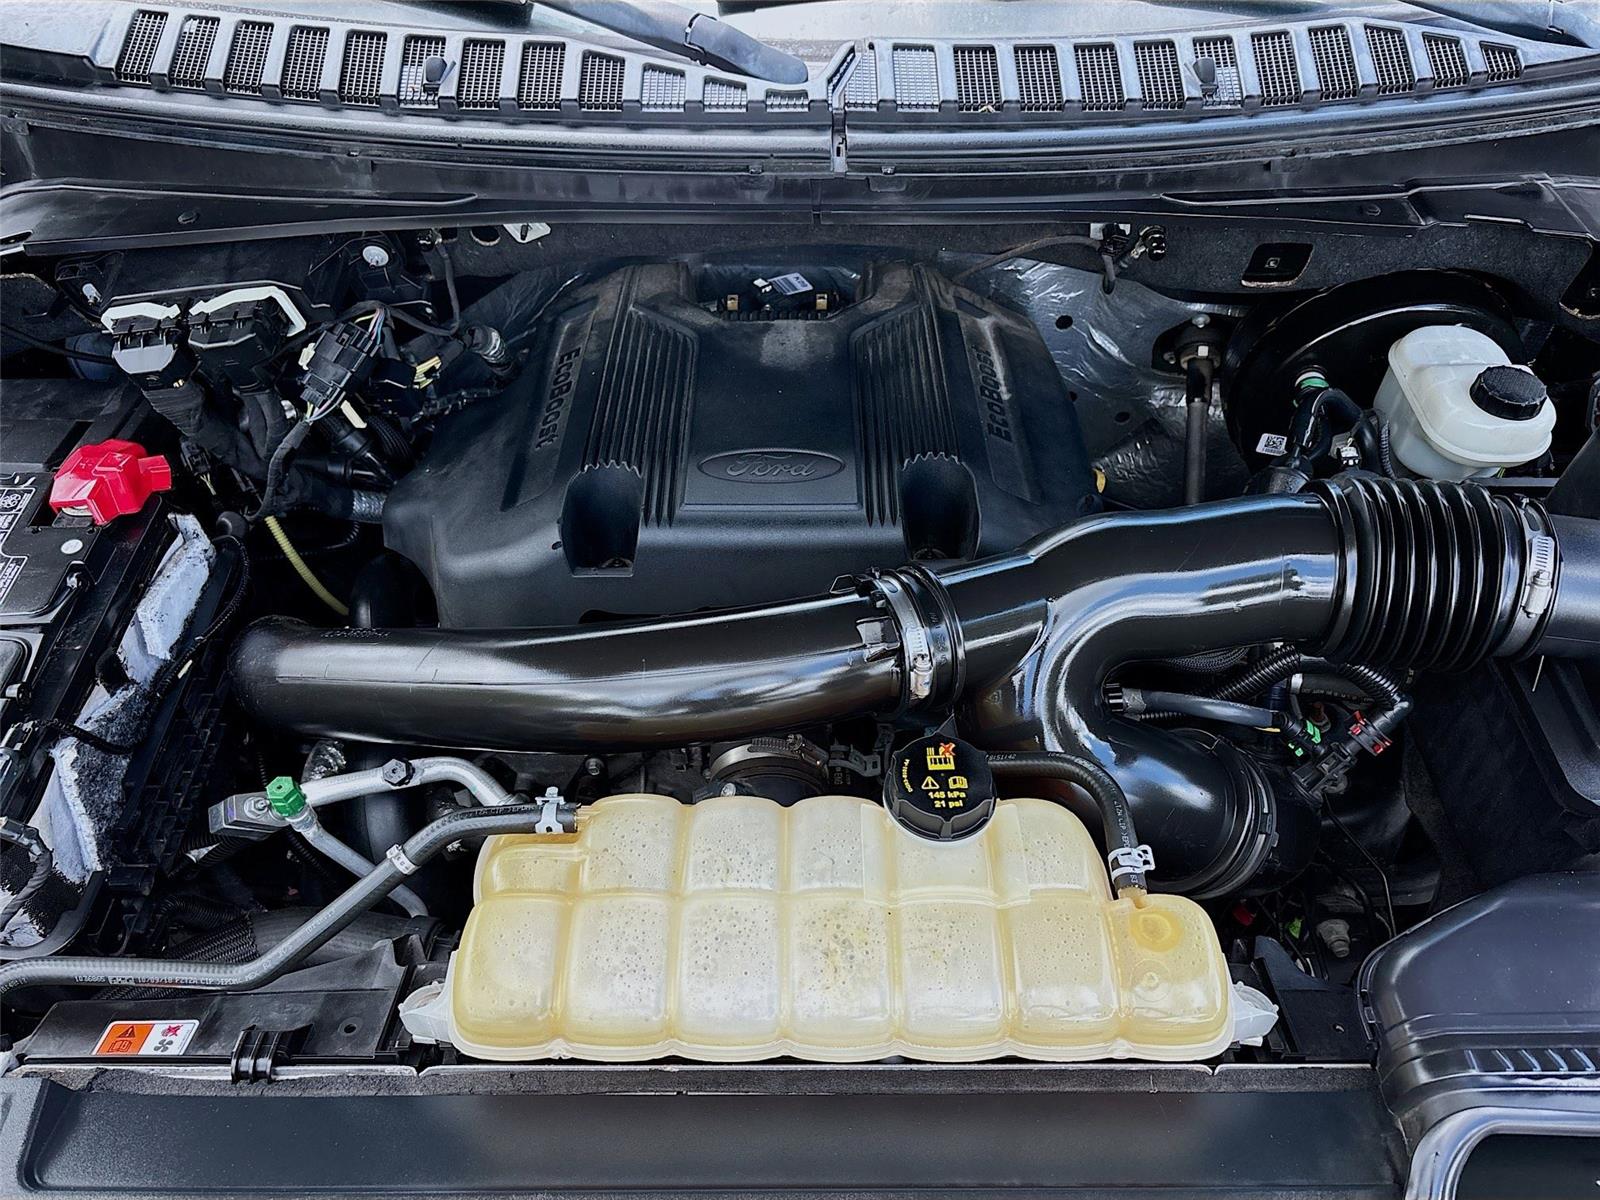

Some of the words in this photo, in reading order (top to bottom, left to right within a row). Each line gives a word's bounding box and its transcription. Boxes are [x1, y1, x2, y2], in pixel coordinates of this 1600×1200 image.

[535, 347, 582, 450] EcoBoost
[971, 345, 1013, 443] EcoBoost
[726, 453, 817, 477] Ford
[928, 791, 946, 799] 145
[947, 791, 966, 799] kPa
[934, 800, 946, 808] 21
[948, 800, 964, 809] psi
